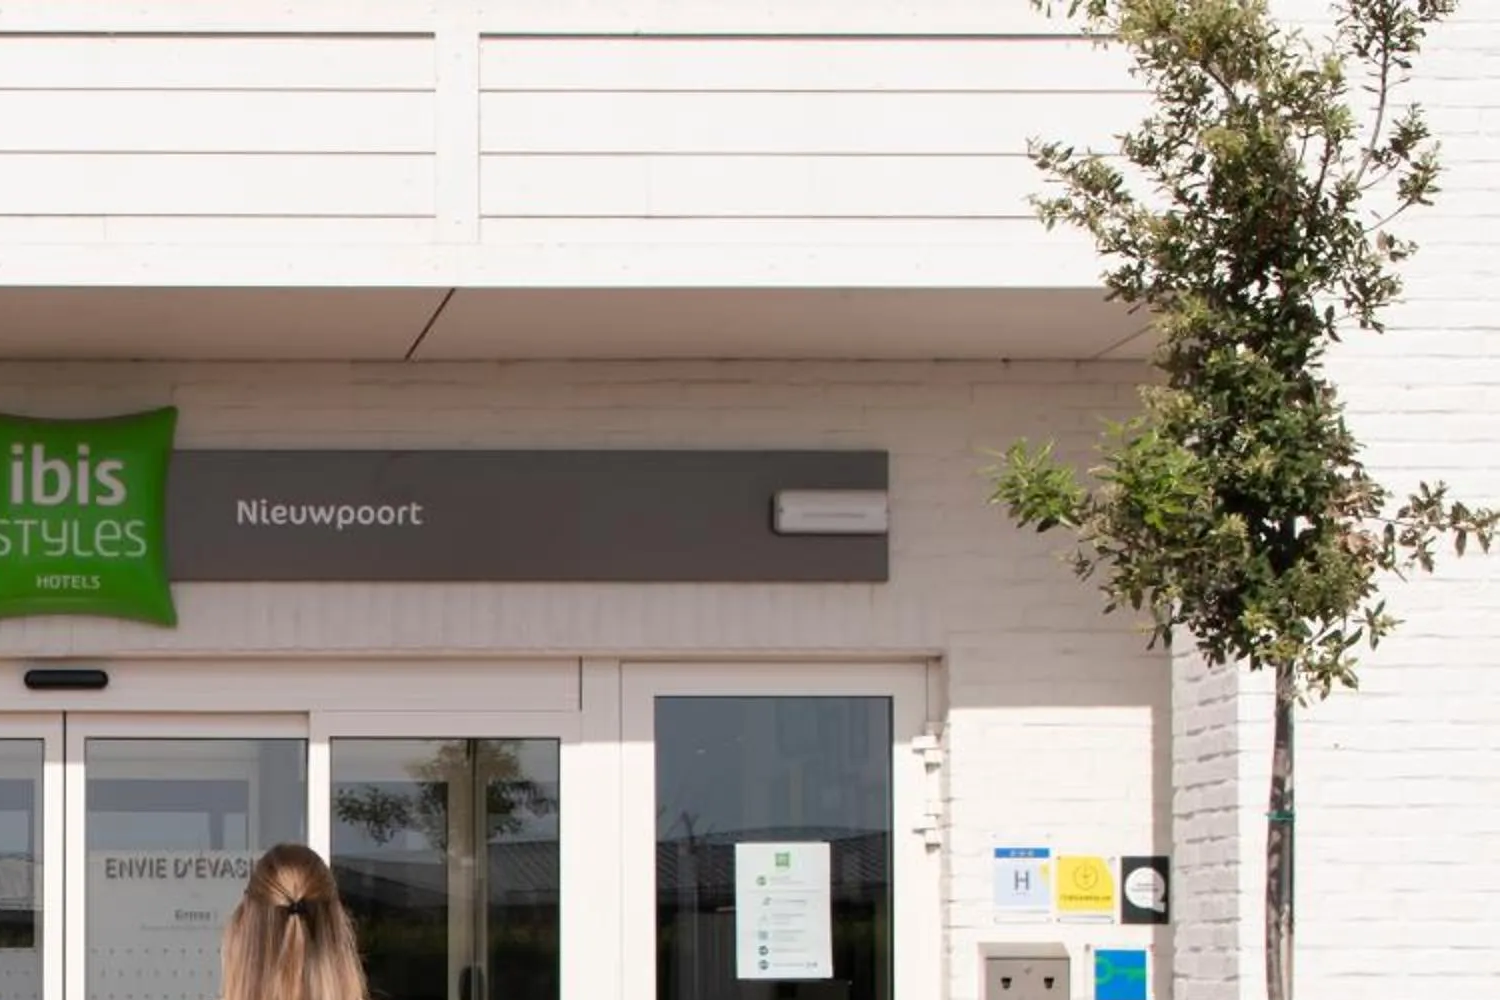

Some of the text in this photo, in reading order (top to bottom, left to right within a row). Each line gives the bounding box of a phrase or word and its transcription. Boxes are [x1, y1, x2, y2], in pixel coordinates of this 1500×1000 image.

[10, 443, 127, 506] ibis
[236, 499, 424, 531] Nieuwpoort
[35, 574, 101, 590] HOTELS
[105, 857, 256, 880] ENVIE D'EVASI
[1014, 869, 1031, 890] H
